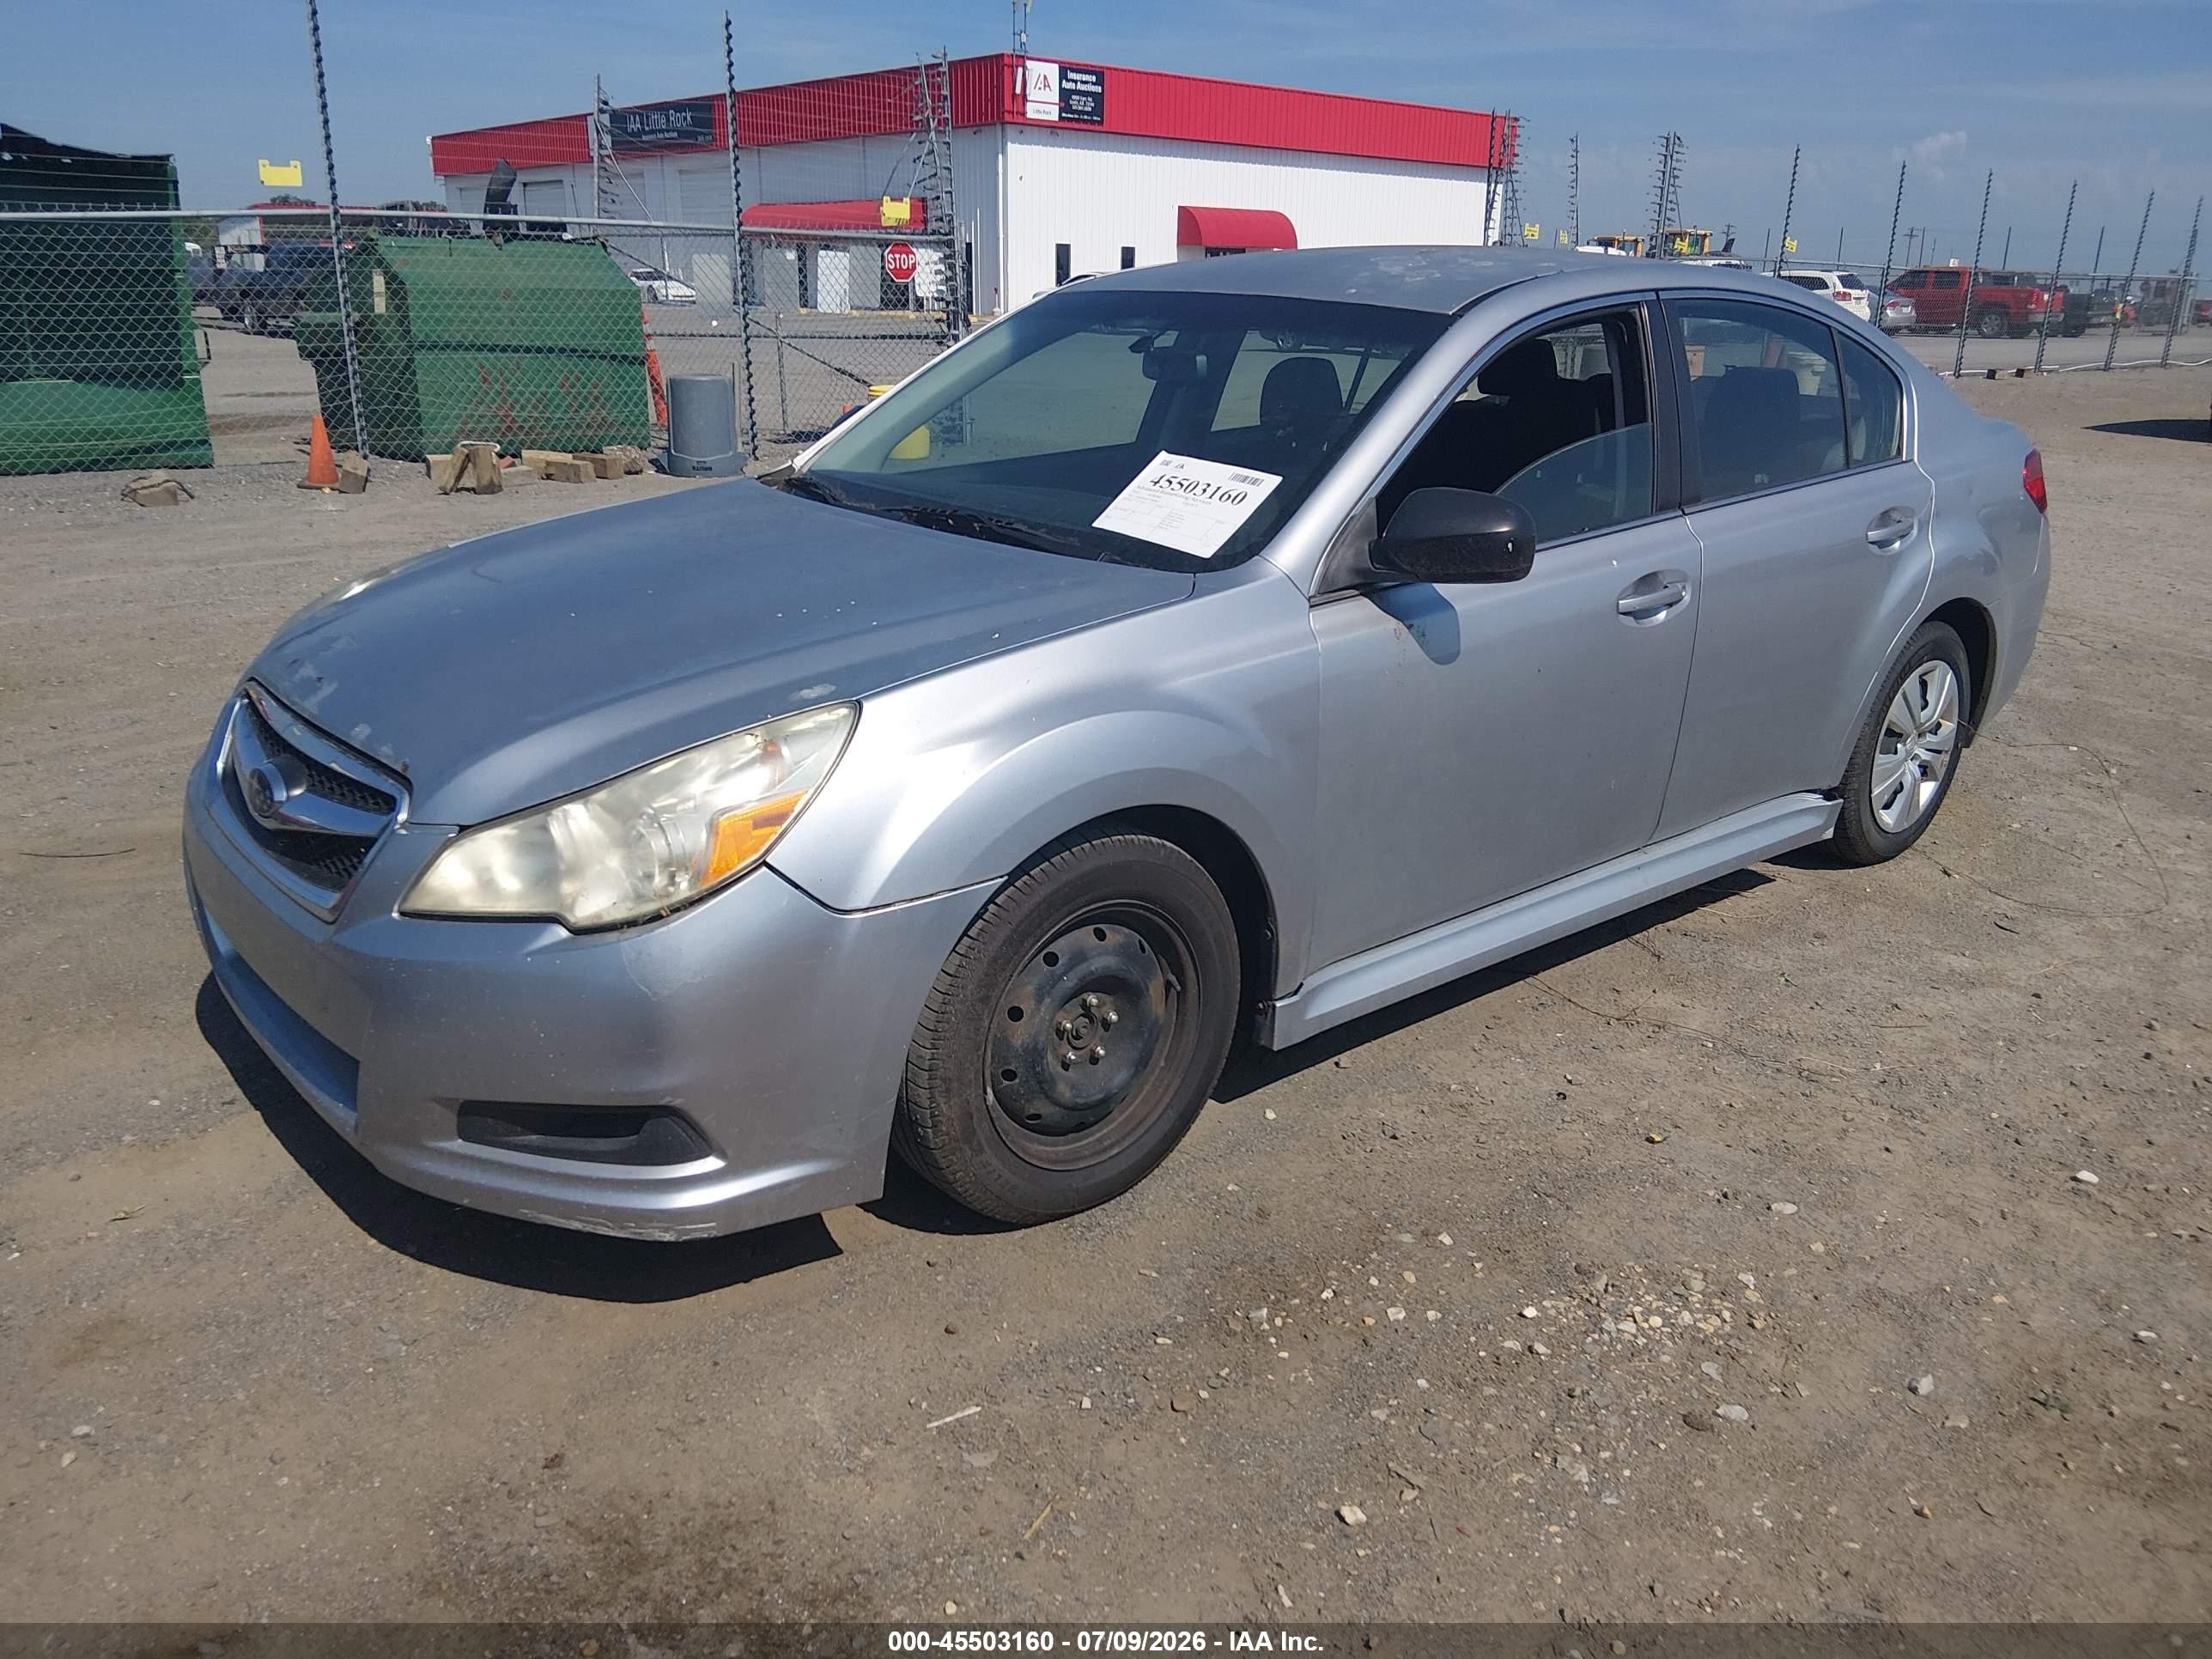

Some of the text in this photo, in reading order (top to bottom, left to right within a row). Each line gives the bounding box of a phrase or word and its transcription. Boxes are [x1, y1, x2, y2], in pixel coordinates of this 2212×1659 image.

[1067, 70, 1096, 82] Insurance
[1062, 80, 1102, 93] Auto Auctions
[626, 108, 693, 133] IAA Little Rock
[887, 253, 915, 270] STOP
[1149, 473, 1249, 507] 45503160
